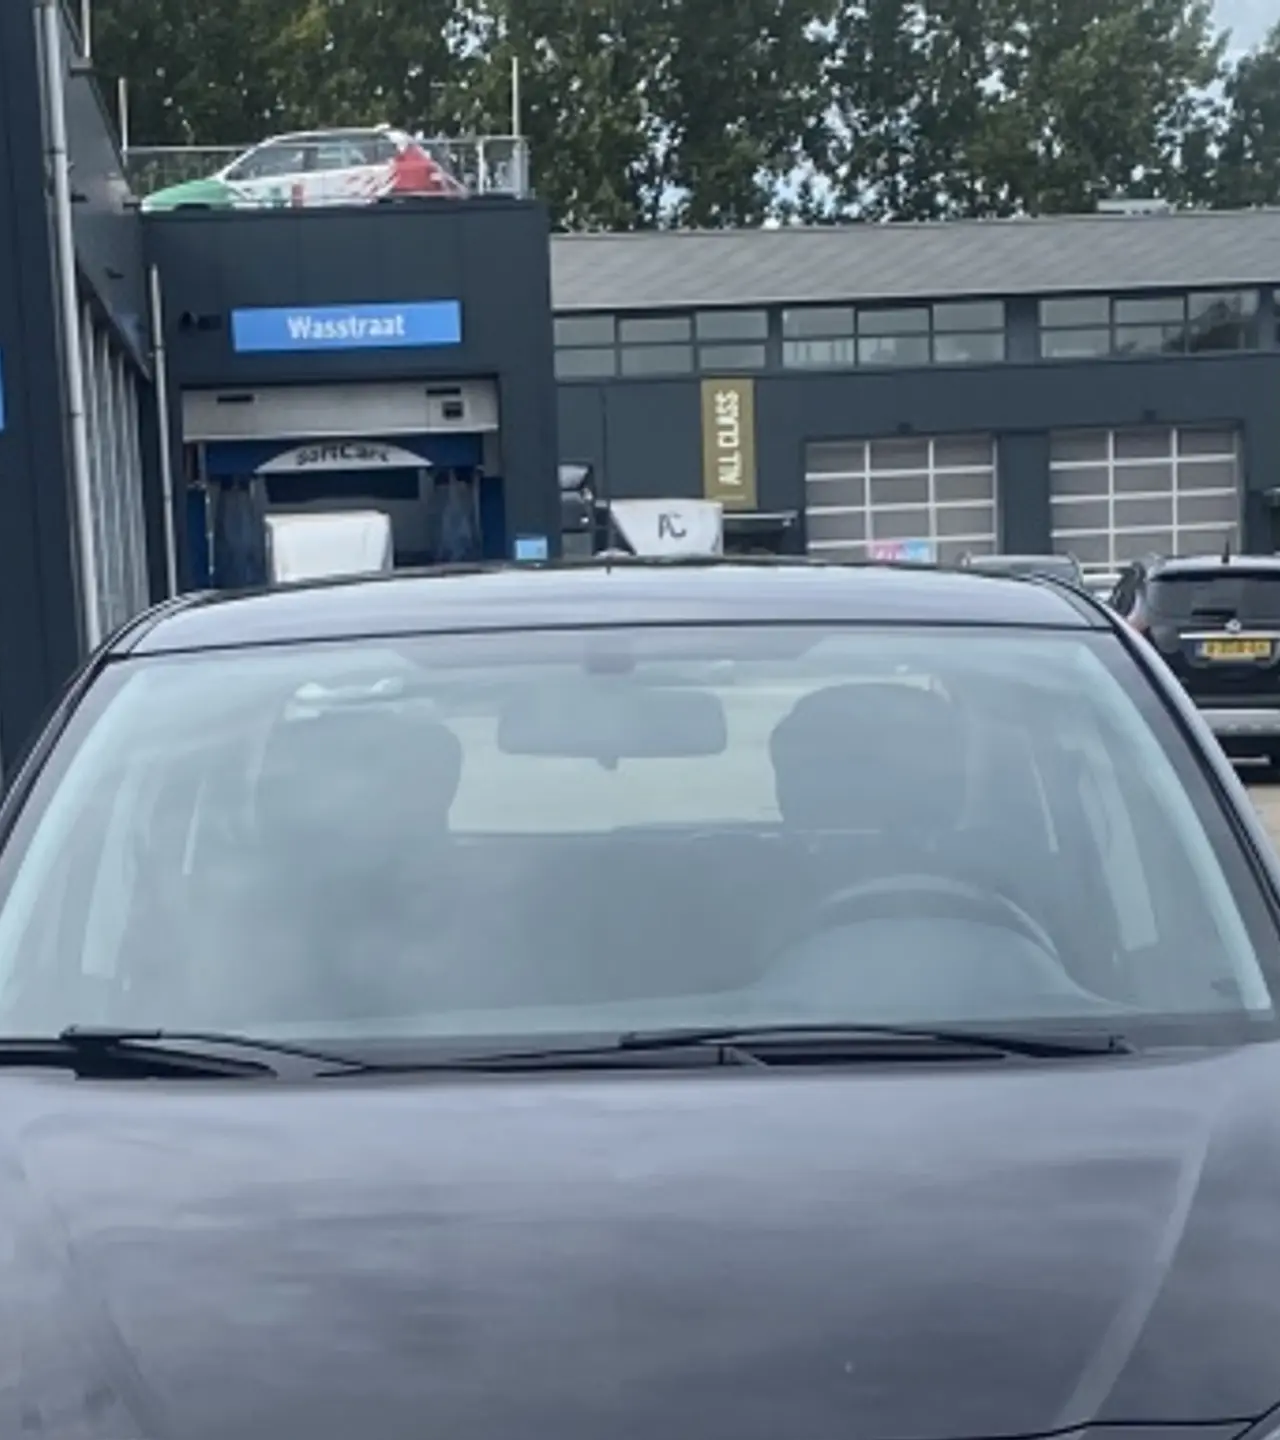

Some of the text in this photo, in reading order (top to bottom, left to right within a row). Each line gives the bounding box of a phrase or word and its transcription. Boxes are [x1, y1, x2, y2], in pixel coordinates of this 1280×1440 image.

[286, 314, 405, 340] Wasstraat
[714, 388, 740, 448] CLASS
[717, 449, 742, 486] ALL
